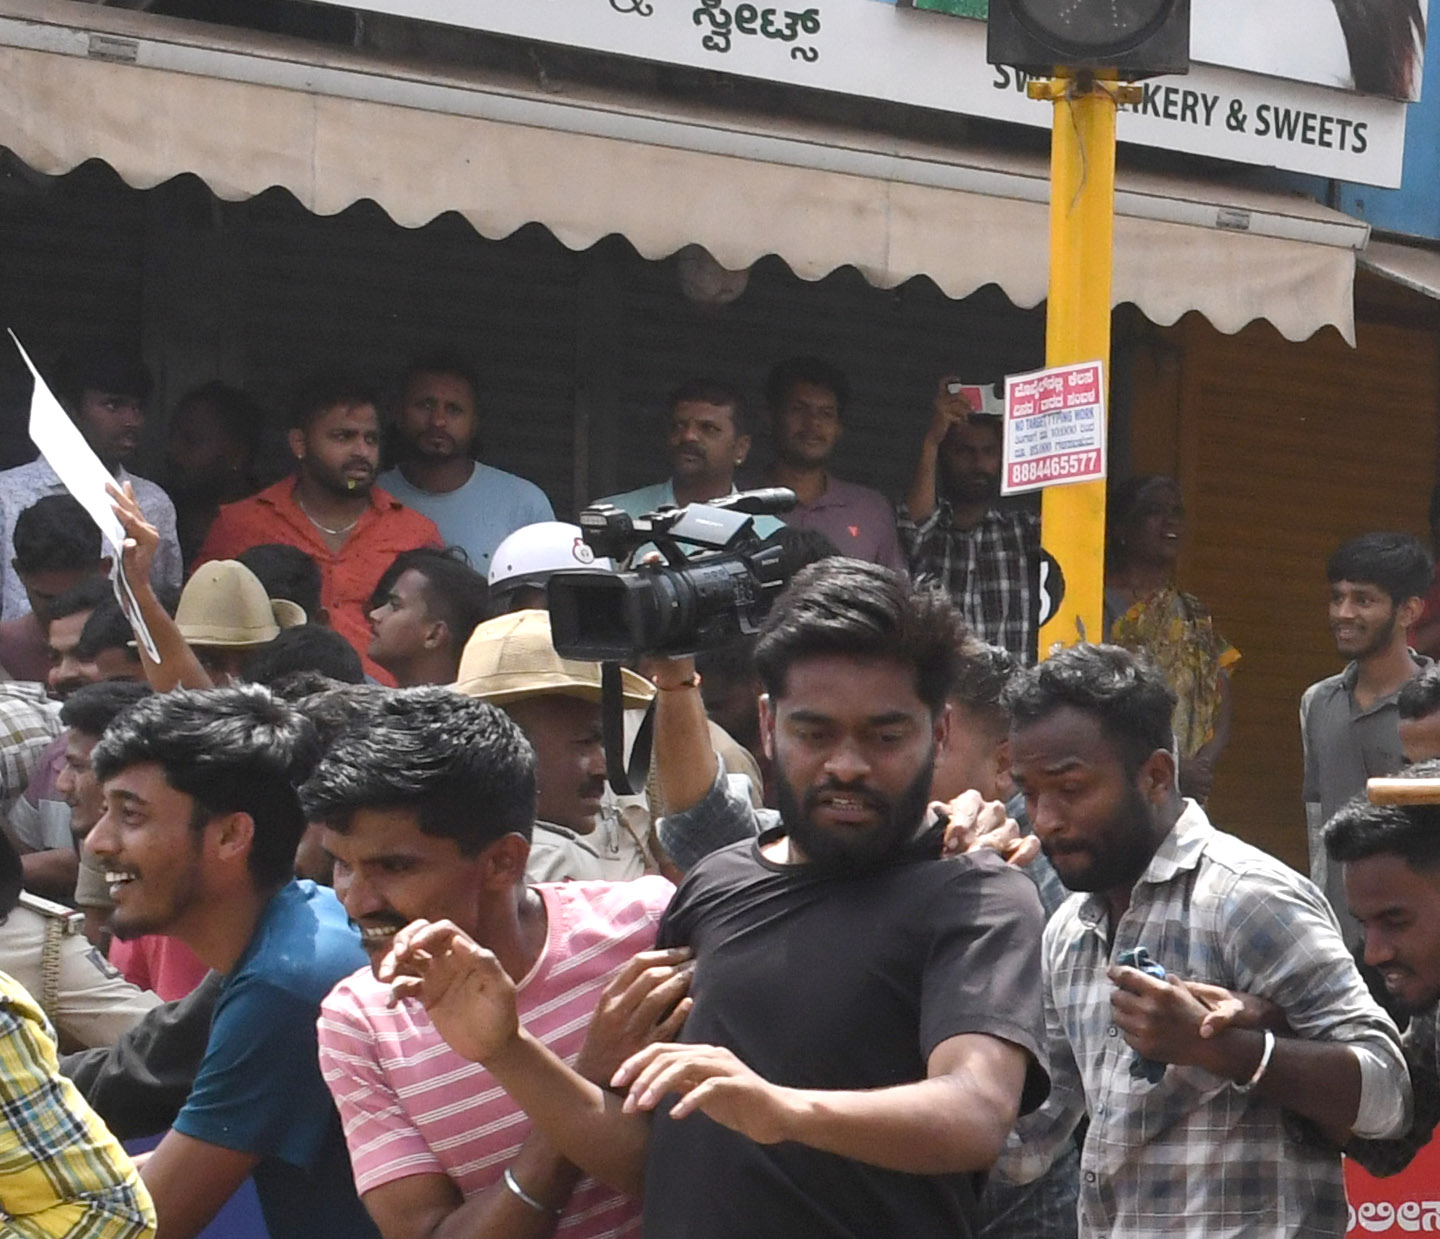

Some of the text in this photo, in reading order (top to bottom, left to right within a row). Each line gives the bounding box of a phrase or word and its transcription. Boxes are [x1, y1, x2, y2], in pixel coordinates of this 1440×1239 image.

[1120, 82, 1369, 154] KERY & SWEETS
[1012, 451, 1098, 483] 8884465577
